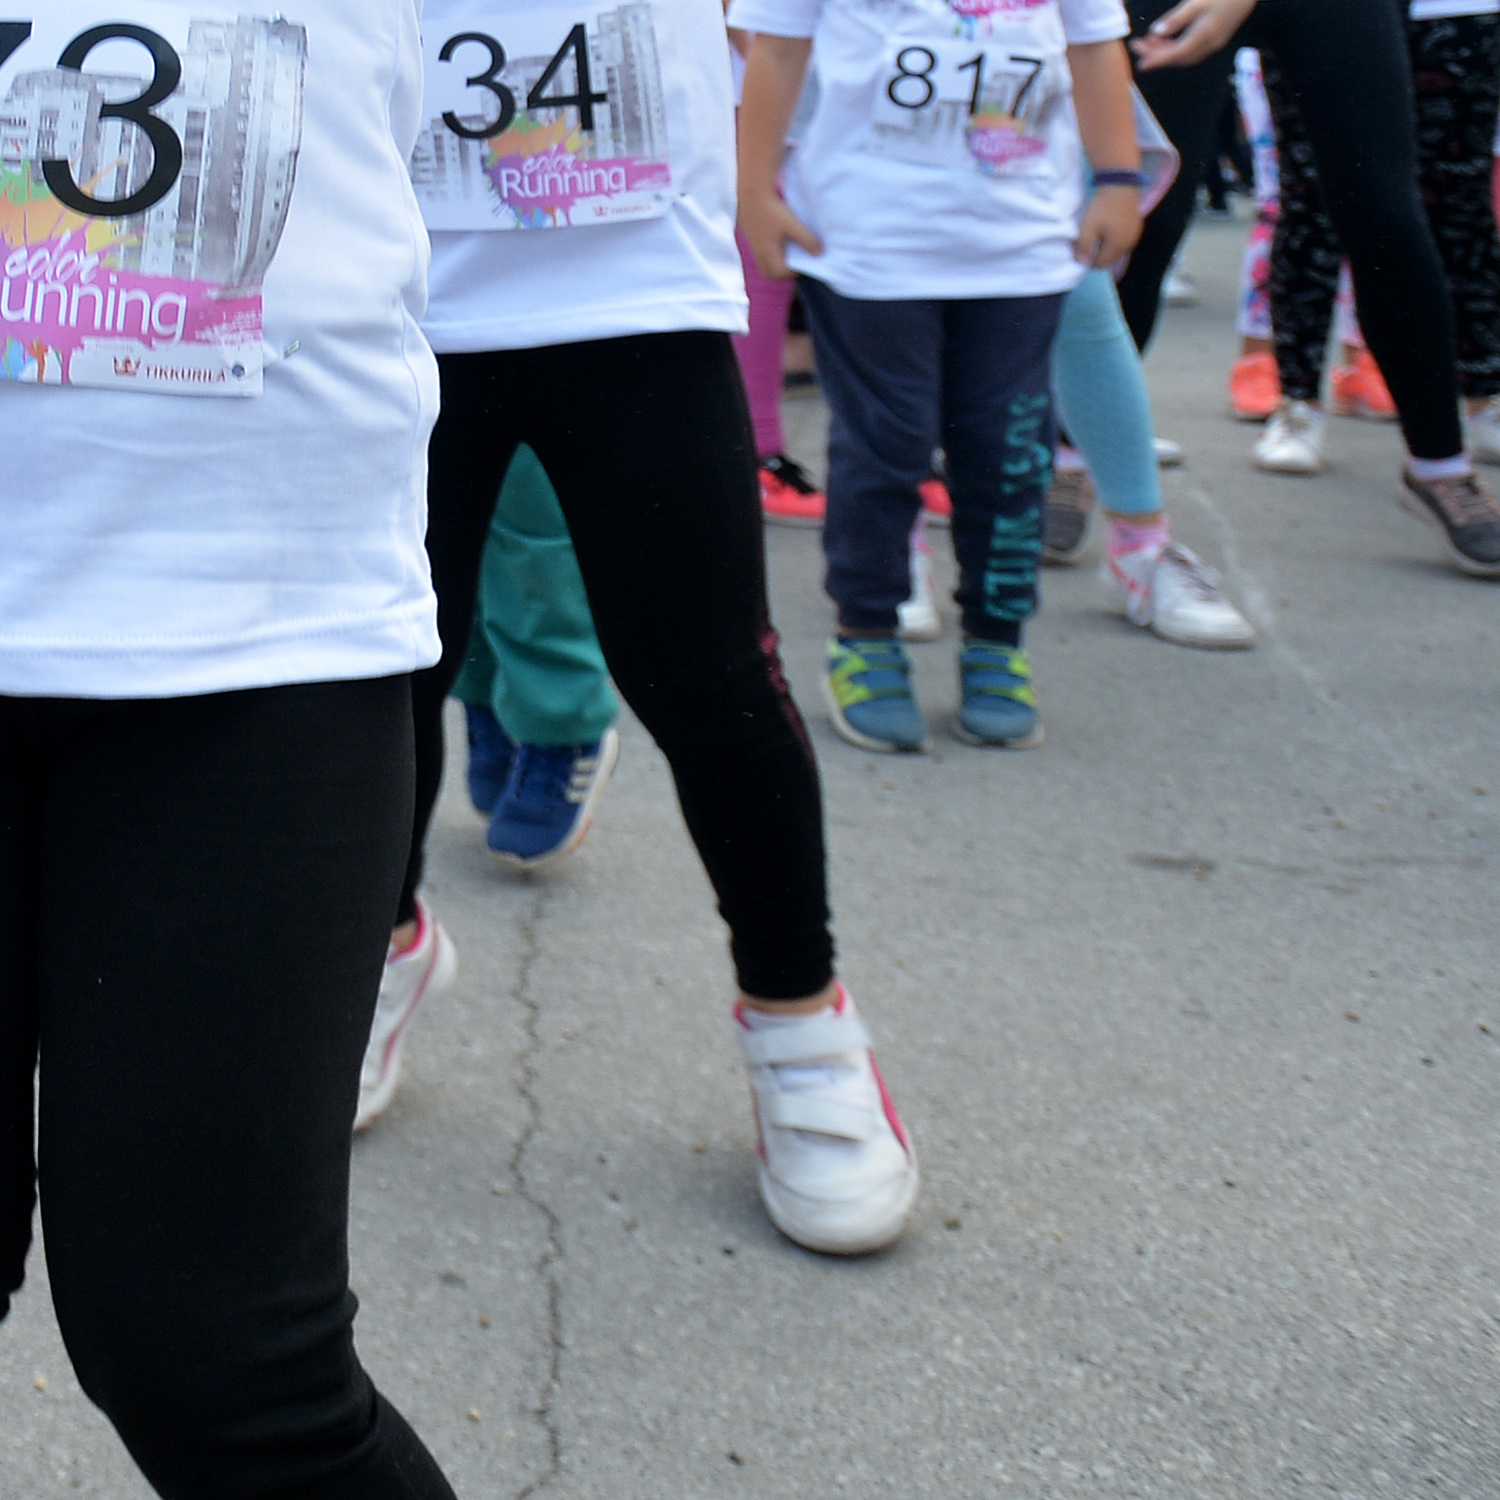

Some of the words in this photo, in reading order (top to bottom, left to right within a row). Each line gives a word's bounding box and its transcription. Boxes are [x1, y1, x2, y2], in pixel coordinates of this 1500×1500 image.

[437, 22, 607, 140] 34
[888, 46, 1045, 119] 817
[500, 164, 627, 200] Running
[5, 228, 100, 284] color
[146, 364, 226, 383] TIKKURILA
